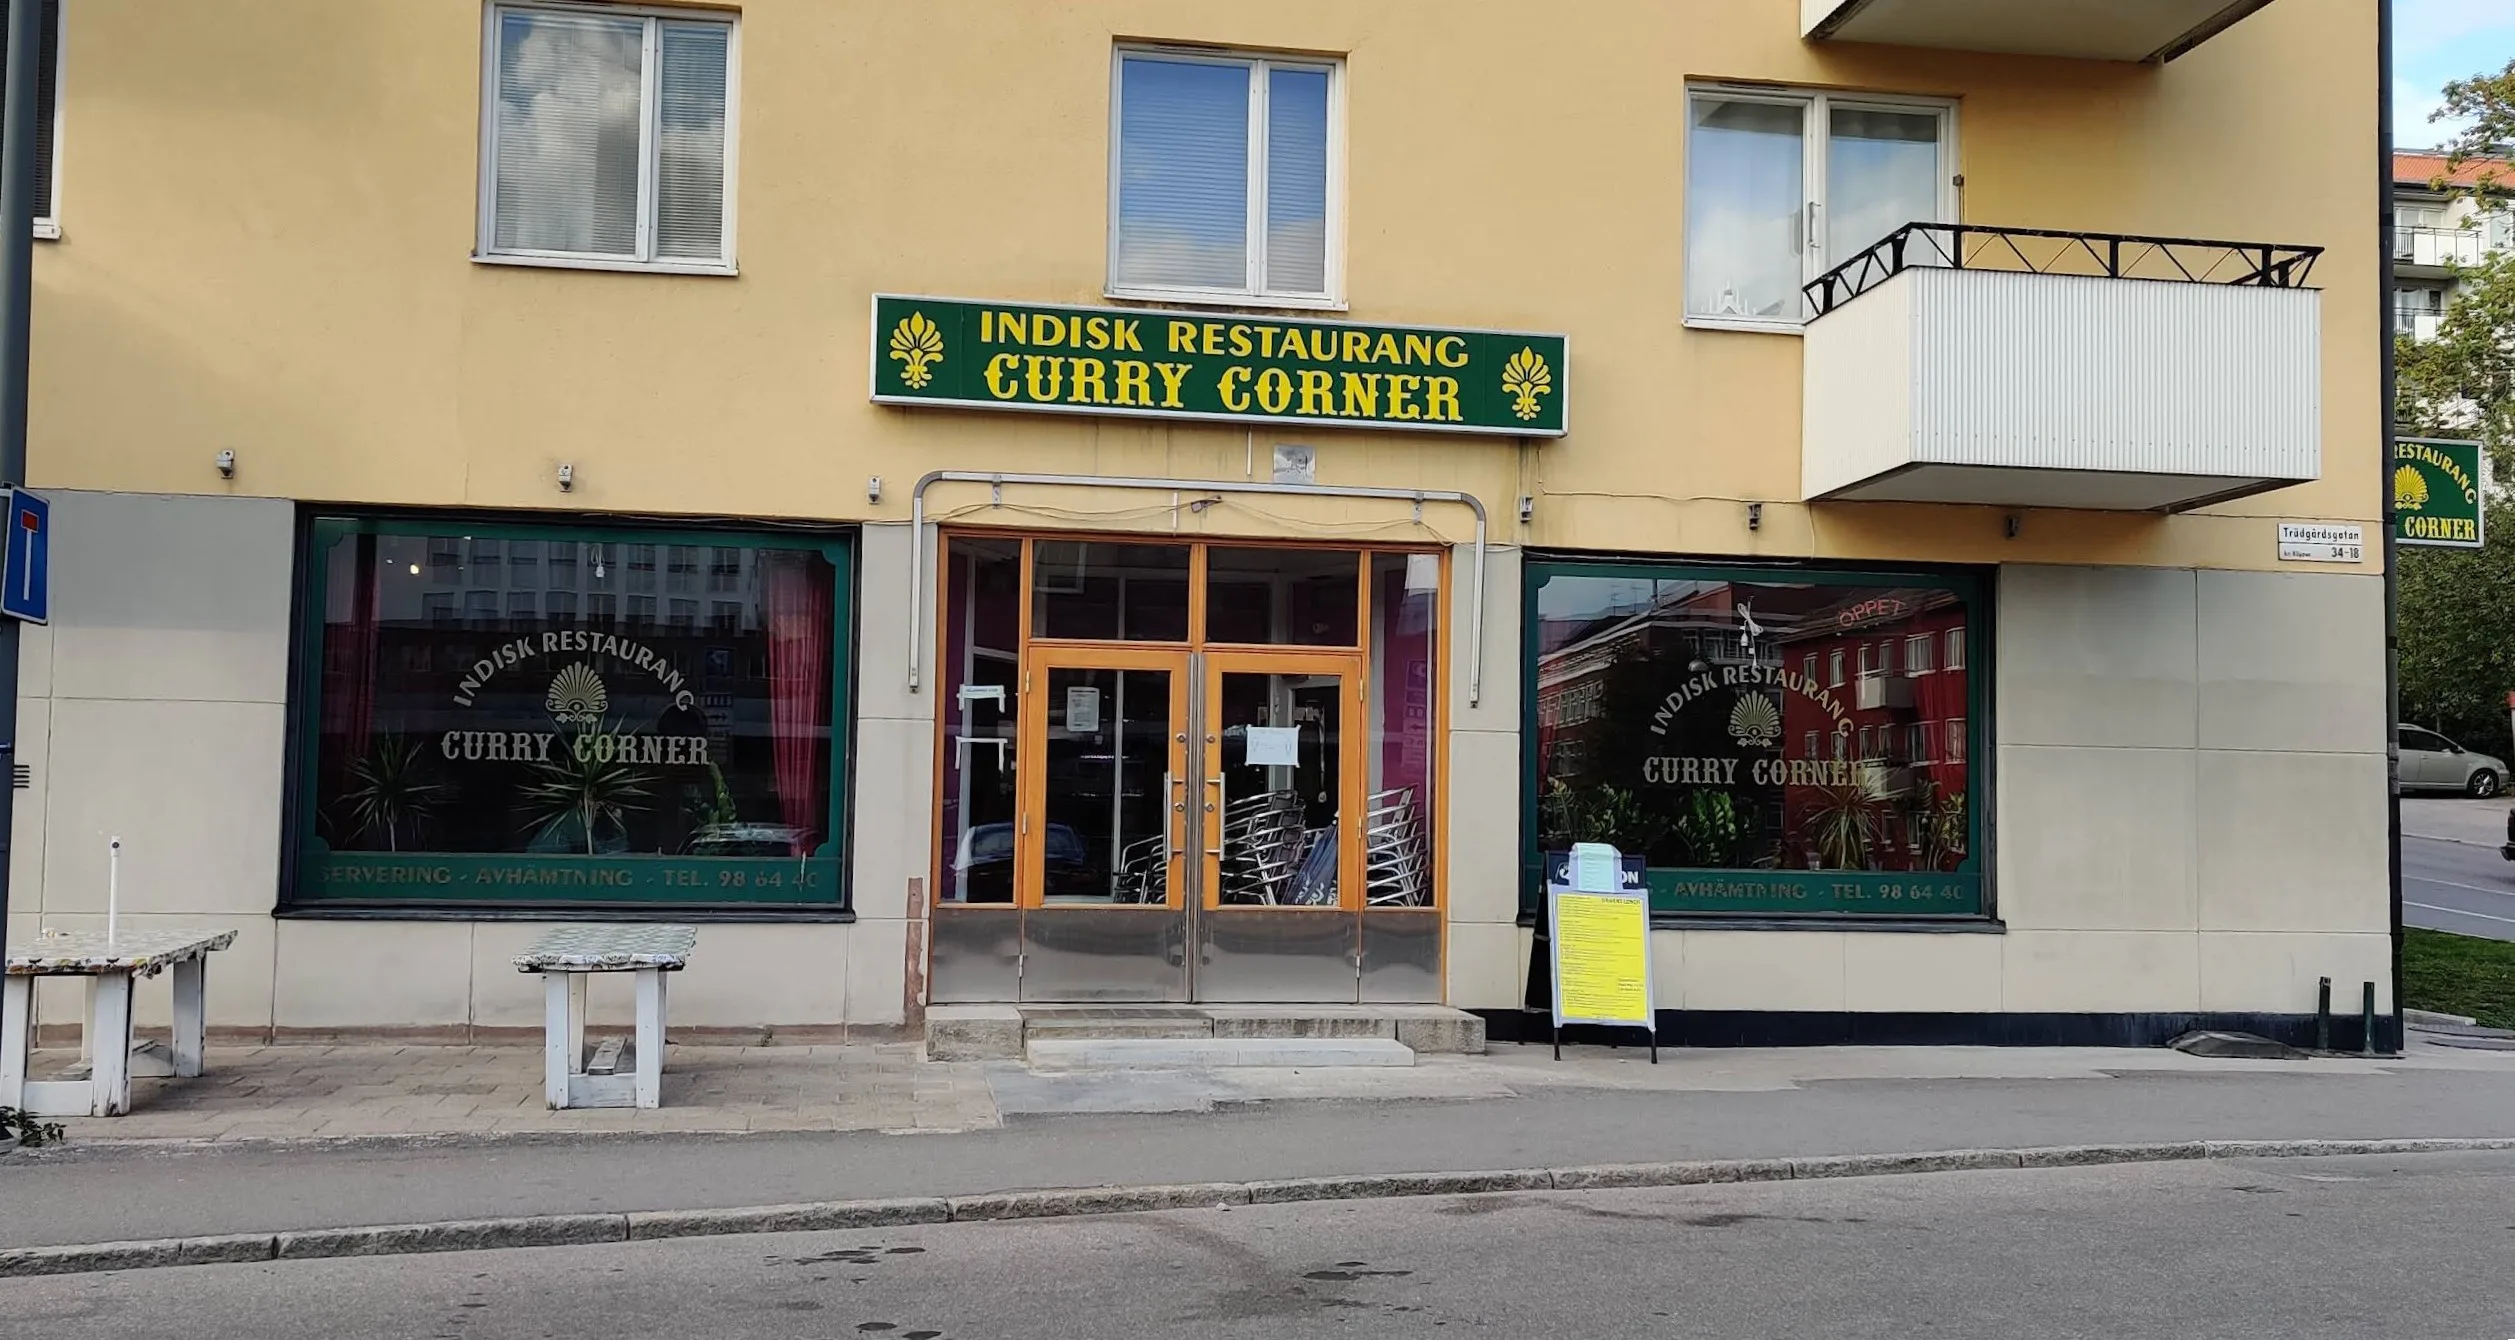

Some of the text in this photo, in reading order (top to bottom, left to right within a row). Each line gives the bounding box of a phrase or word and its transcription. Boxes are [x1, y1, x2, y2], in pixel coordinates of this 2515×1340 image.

[980, 310, 1470, 368] INDISK RESTAURANG
[983, 352, 1464, 423] CURRY CORNER
[2283, 527, 2359, 542] Trädgårdsgatan
[2405, 516, 2476, 540] CORNER
[2331, 547, 2359, 558] 34-18
[453, 630, 694, 711] INDISK RESTAURANG
[1650, 666, 1855, 738] INDISK RESTAURANG
[441, 730, 711, 765] CURRY CORNER
[1643, 757, 1868, 787] CURRY CORNER
[320, 866, 451, 884] SERVERING
[475, 864, 633, 887] AVHÄMTNING
[663, 870, 709, 887] TEL.
[719, 870, 746, 887] 98
[755, 870, 782, 887] 64
[1831, 884, 1871, 899] TEL.
[1879, 884, 1902, 899] 98
[1910, 885, 1933, 900] 64
